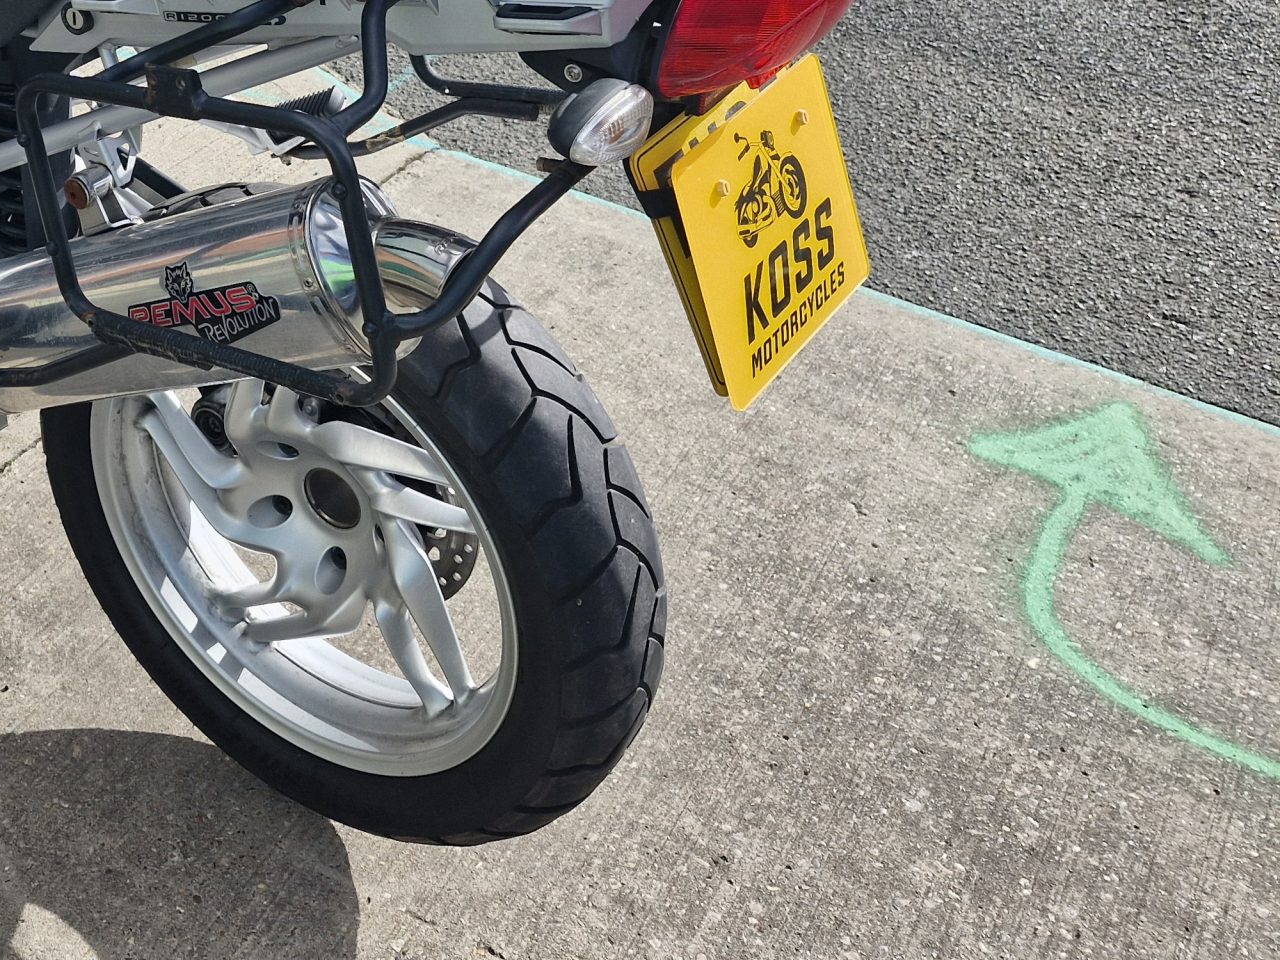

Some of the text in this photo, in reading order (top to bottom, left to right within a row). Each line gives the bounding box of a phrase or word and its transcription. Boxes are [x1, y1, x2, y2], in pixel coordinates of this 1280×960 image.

[129, 286, 257, 327] REMUS
[743, 196, 835, 346] KOSS
[751, 261, 845, 379] MOTORCYCLES
